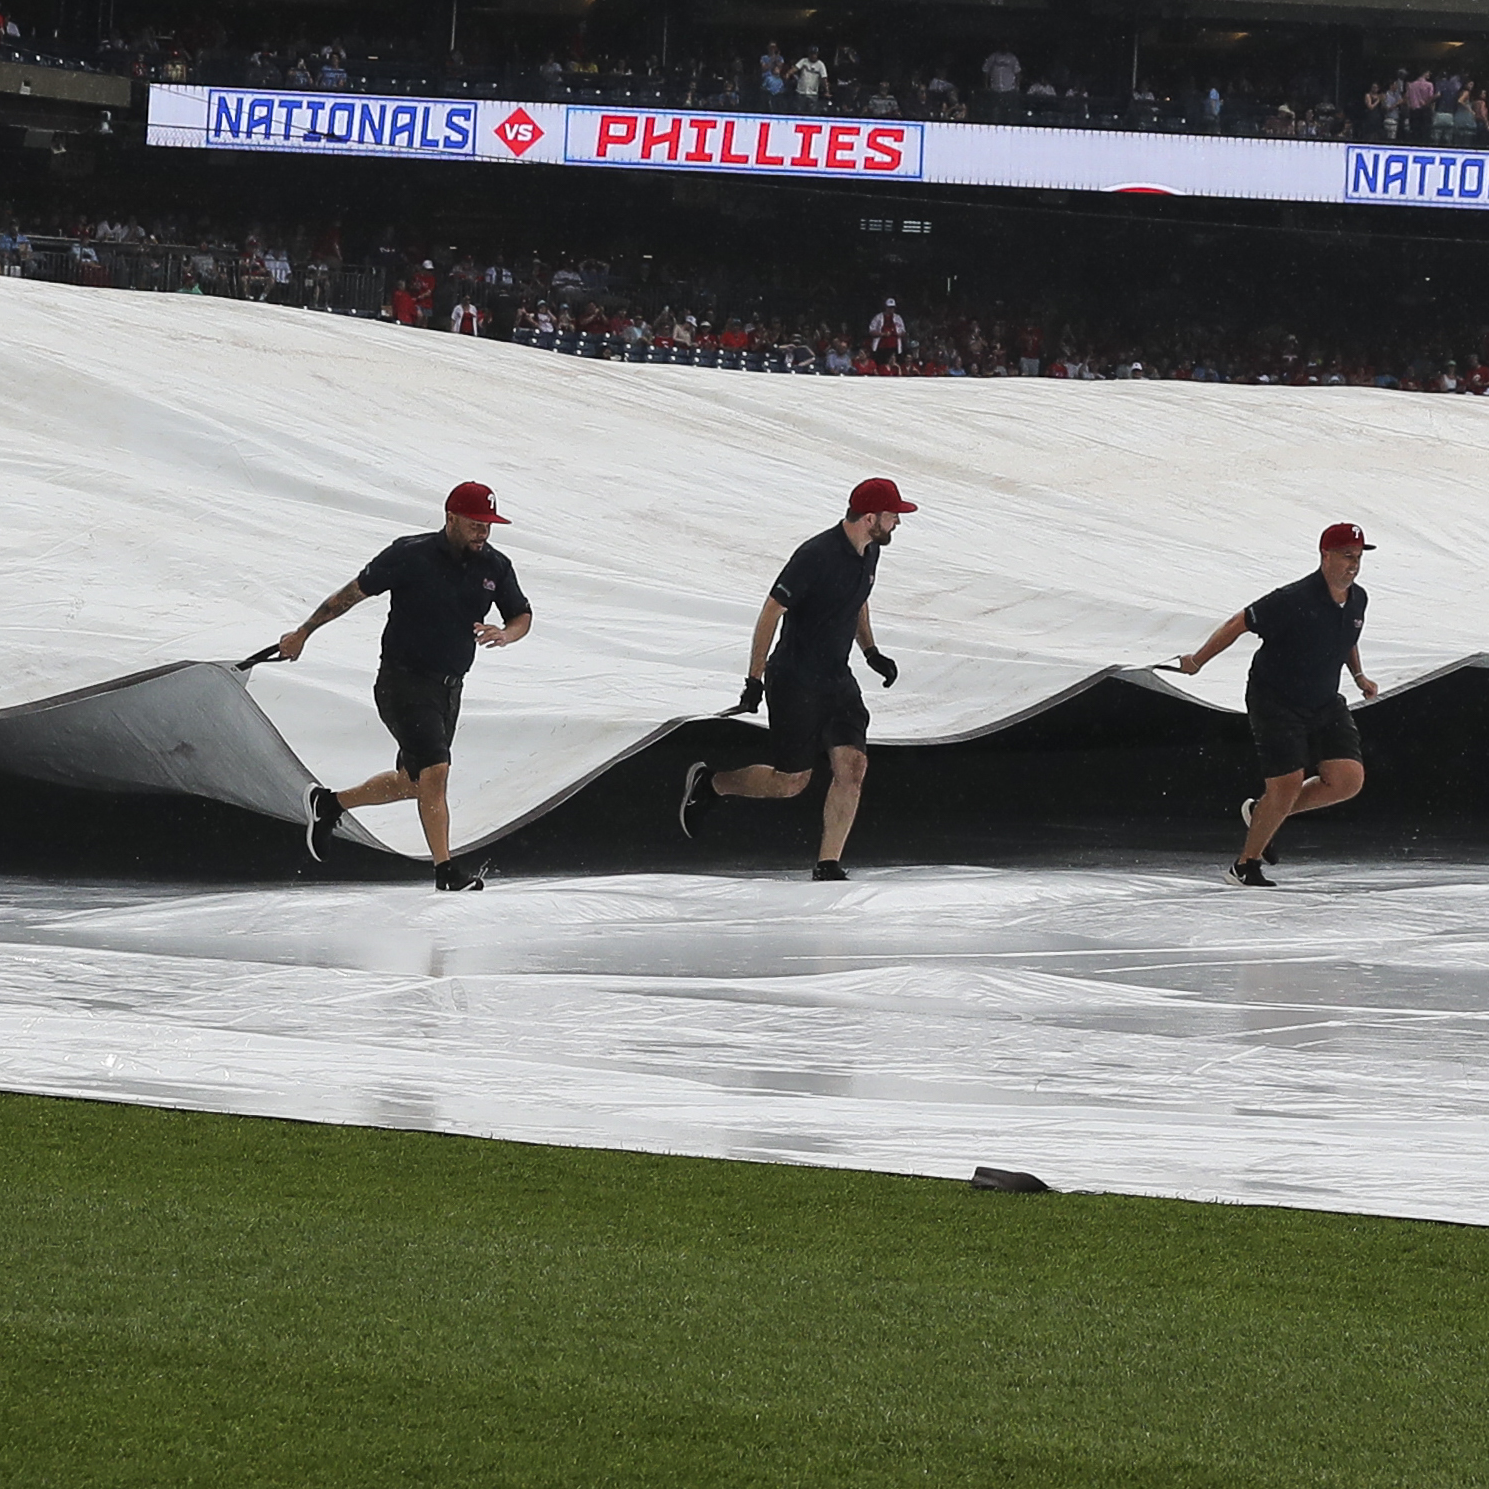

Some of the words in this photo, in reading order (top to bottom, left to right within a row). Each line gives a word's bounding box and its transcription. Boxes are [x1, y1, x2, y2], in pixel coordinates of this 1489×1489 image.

[214, 96, 473, 150] NATIONALS
[504, 123, 534, 142] VS
[597, 114, 904, 171] PHILLIES
